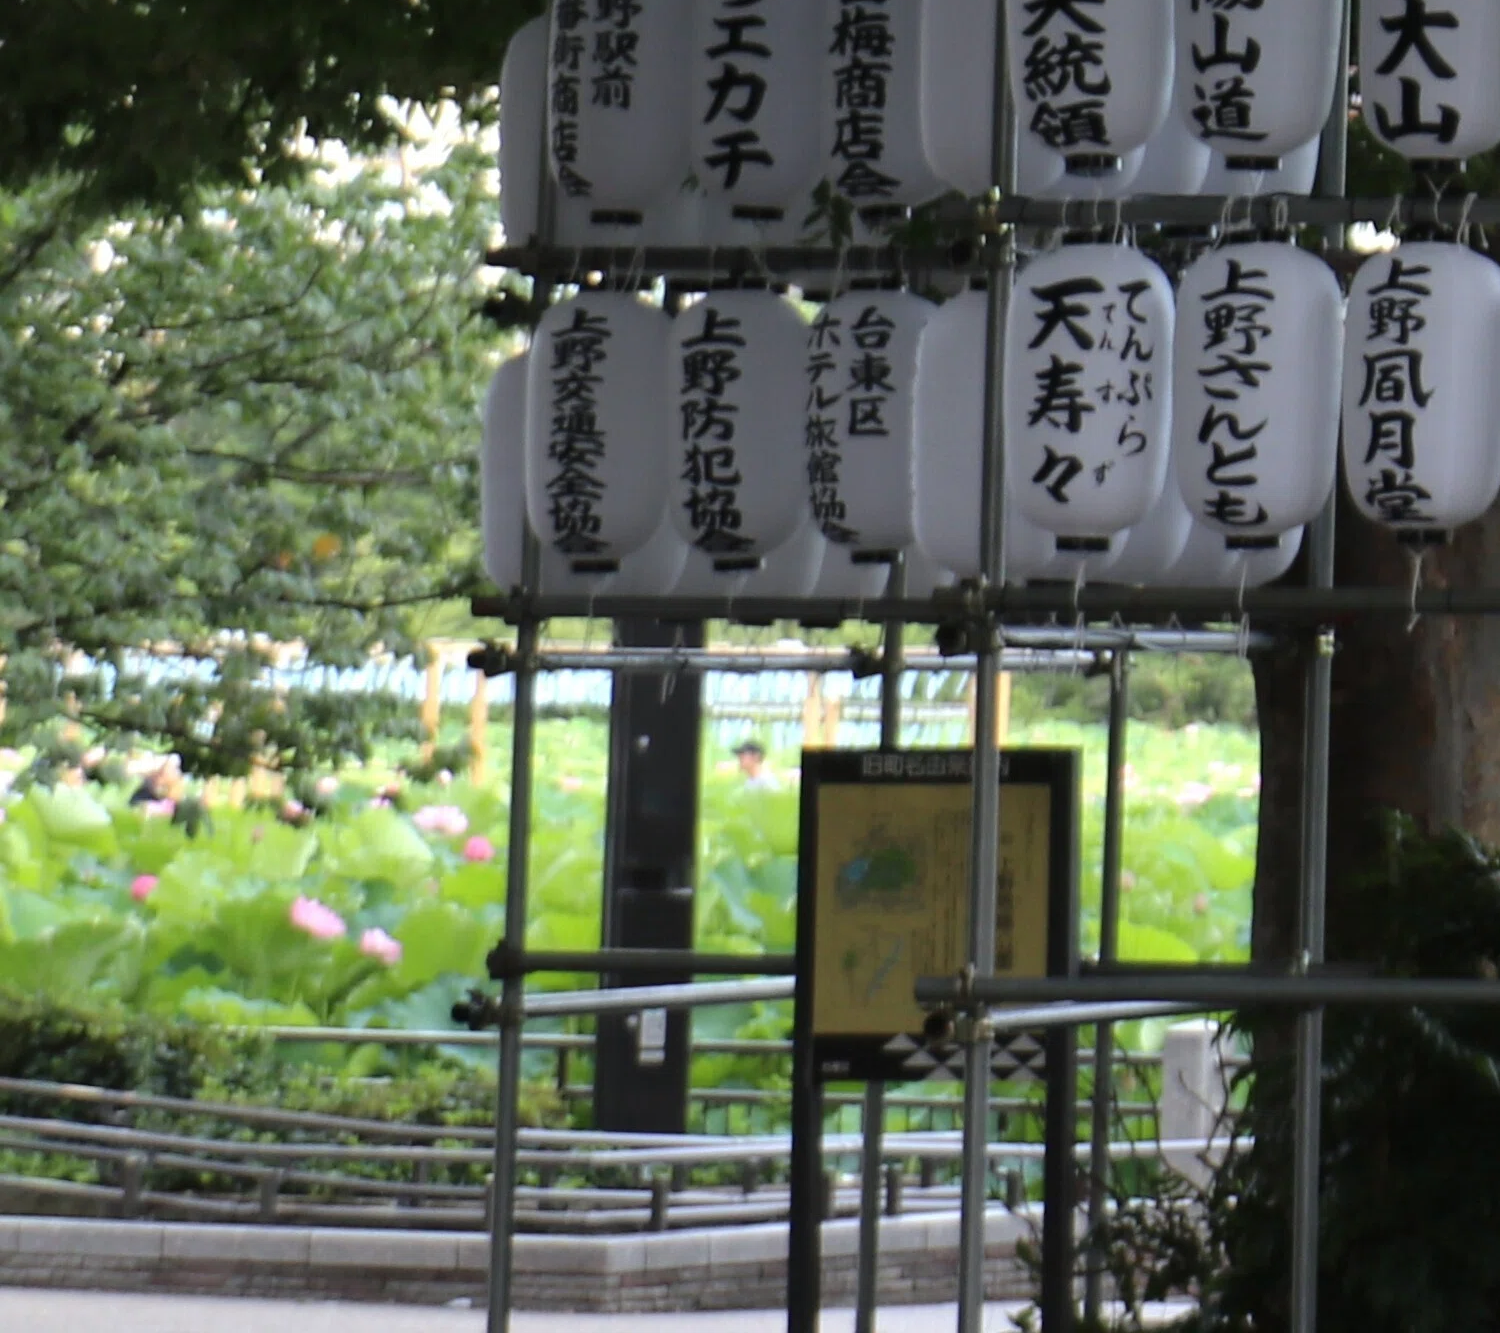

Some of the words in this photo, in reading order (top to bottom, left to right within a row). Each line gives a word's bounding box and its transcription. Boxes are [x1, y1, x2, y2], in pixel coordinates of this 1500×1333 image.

[544, 309, 612, 557] 上野交通安全協会
[681, 309, 757, 555] 上野防犯協会
[804, 315, 861, 546] ホテル旅館協会
[846, 305, 896, 437] 台東区
[1027, 277, 1105, 505] 天寿々
[1115, 279, 1154, 456] てんぷら
[1197, 259, 1275, 531] 上野さんとも
